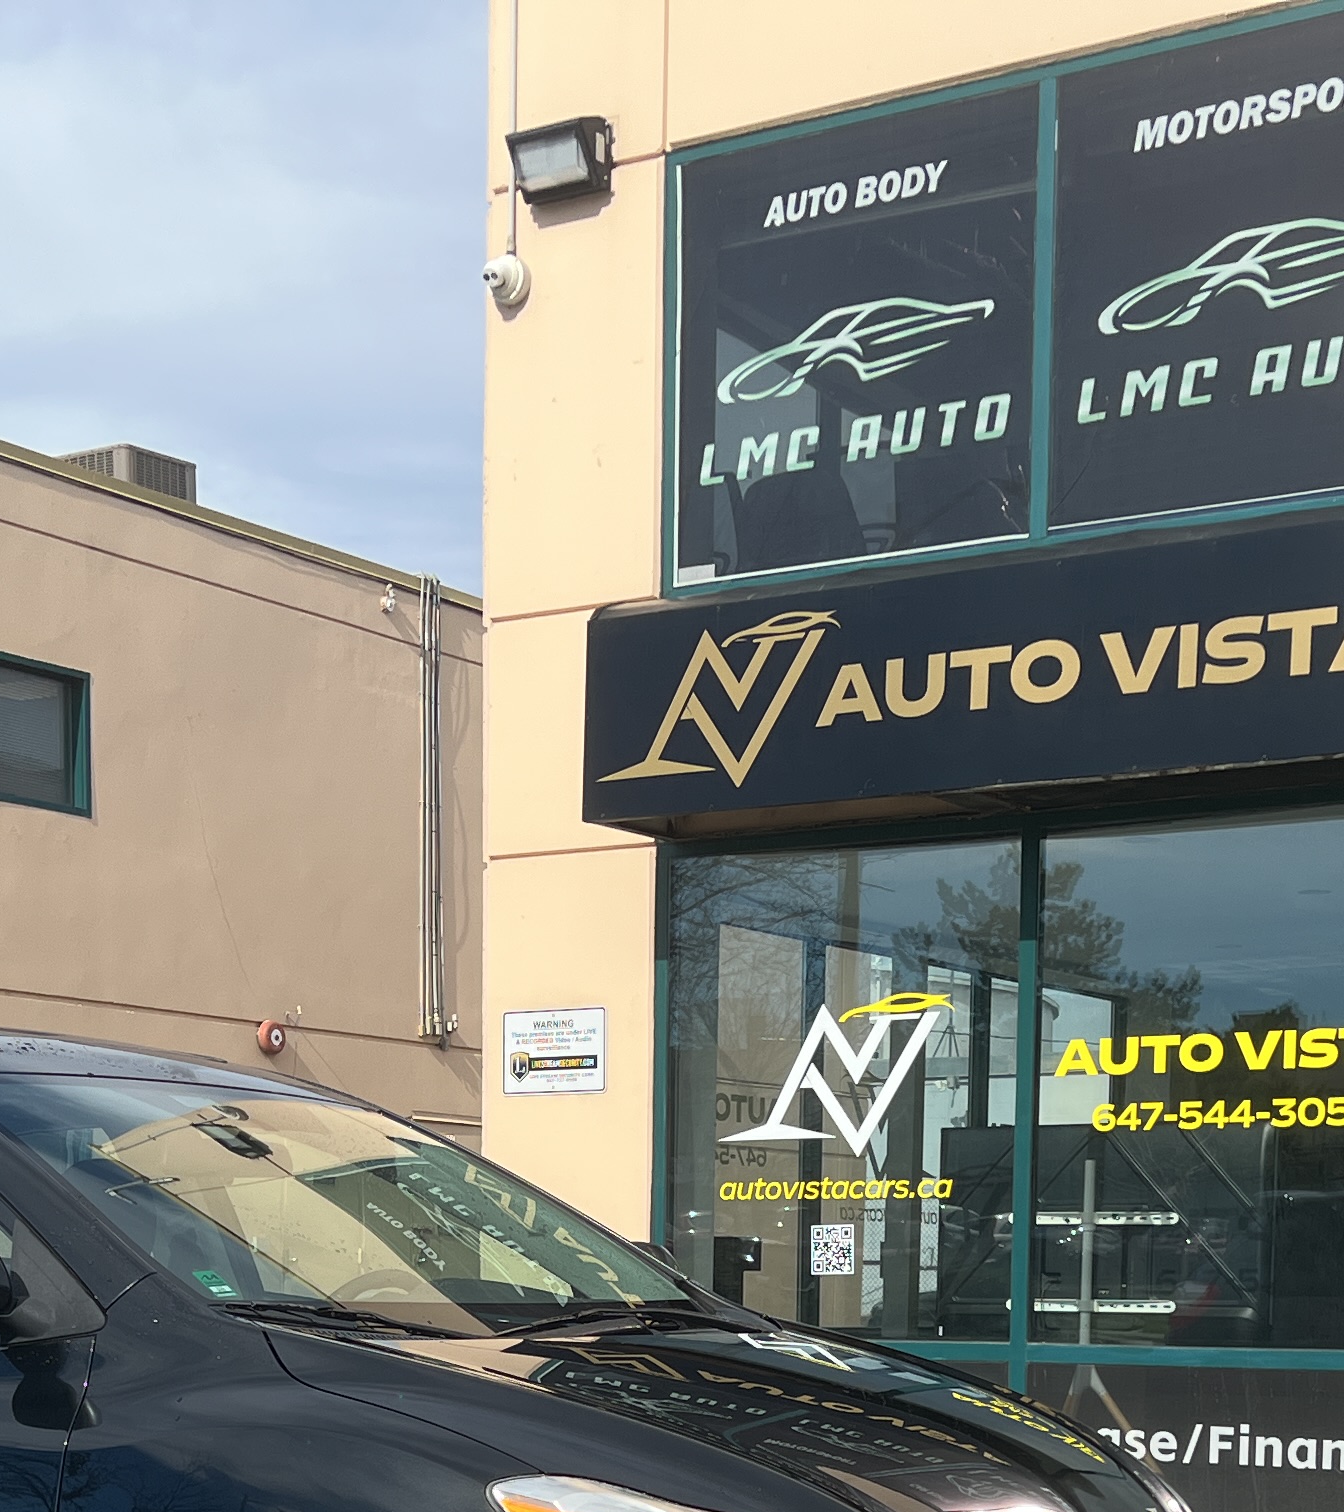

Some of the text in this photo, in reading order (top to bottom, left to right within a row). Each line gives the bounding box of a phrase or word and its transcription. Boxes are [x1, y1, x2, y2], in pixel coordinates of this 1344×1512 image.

[763, 159, 949, 229] AUTO BODY
[1077, 357, 1219, 424] LMC
[699, 393, 1011, 486] LMC AUTO
[814, 638, 1081, 728] AUTO
[533, 1019, 574, 1030] WARNING
[1054, 1032, 1225, 1078] AUTO
[719, 1177, 954, 1201] autovistacars.ca
